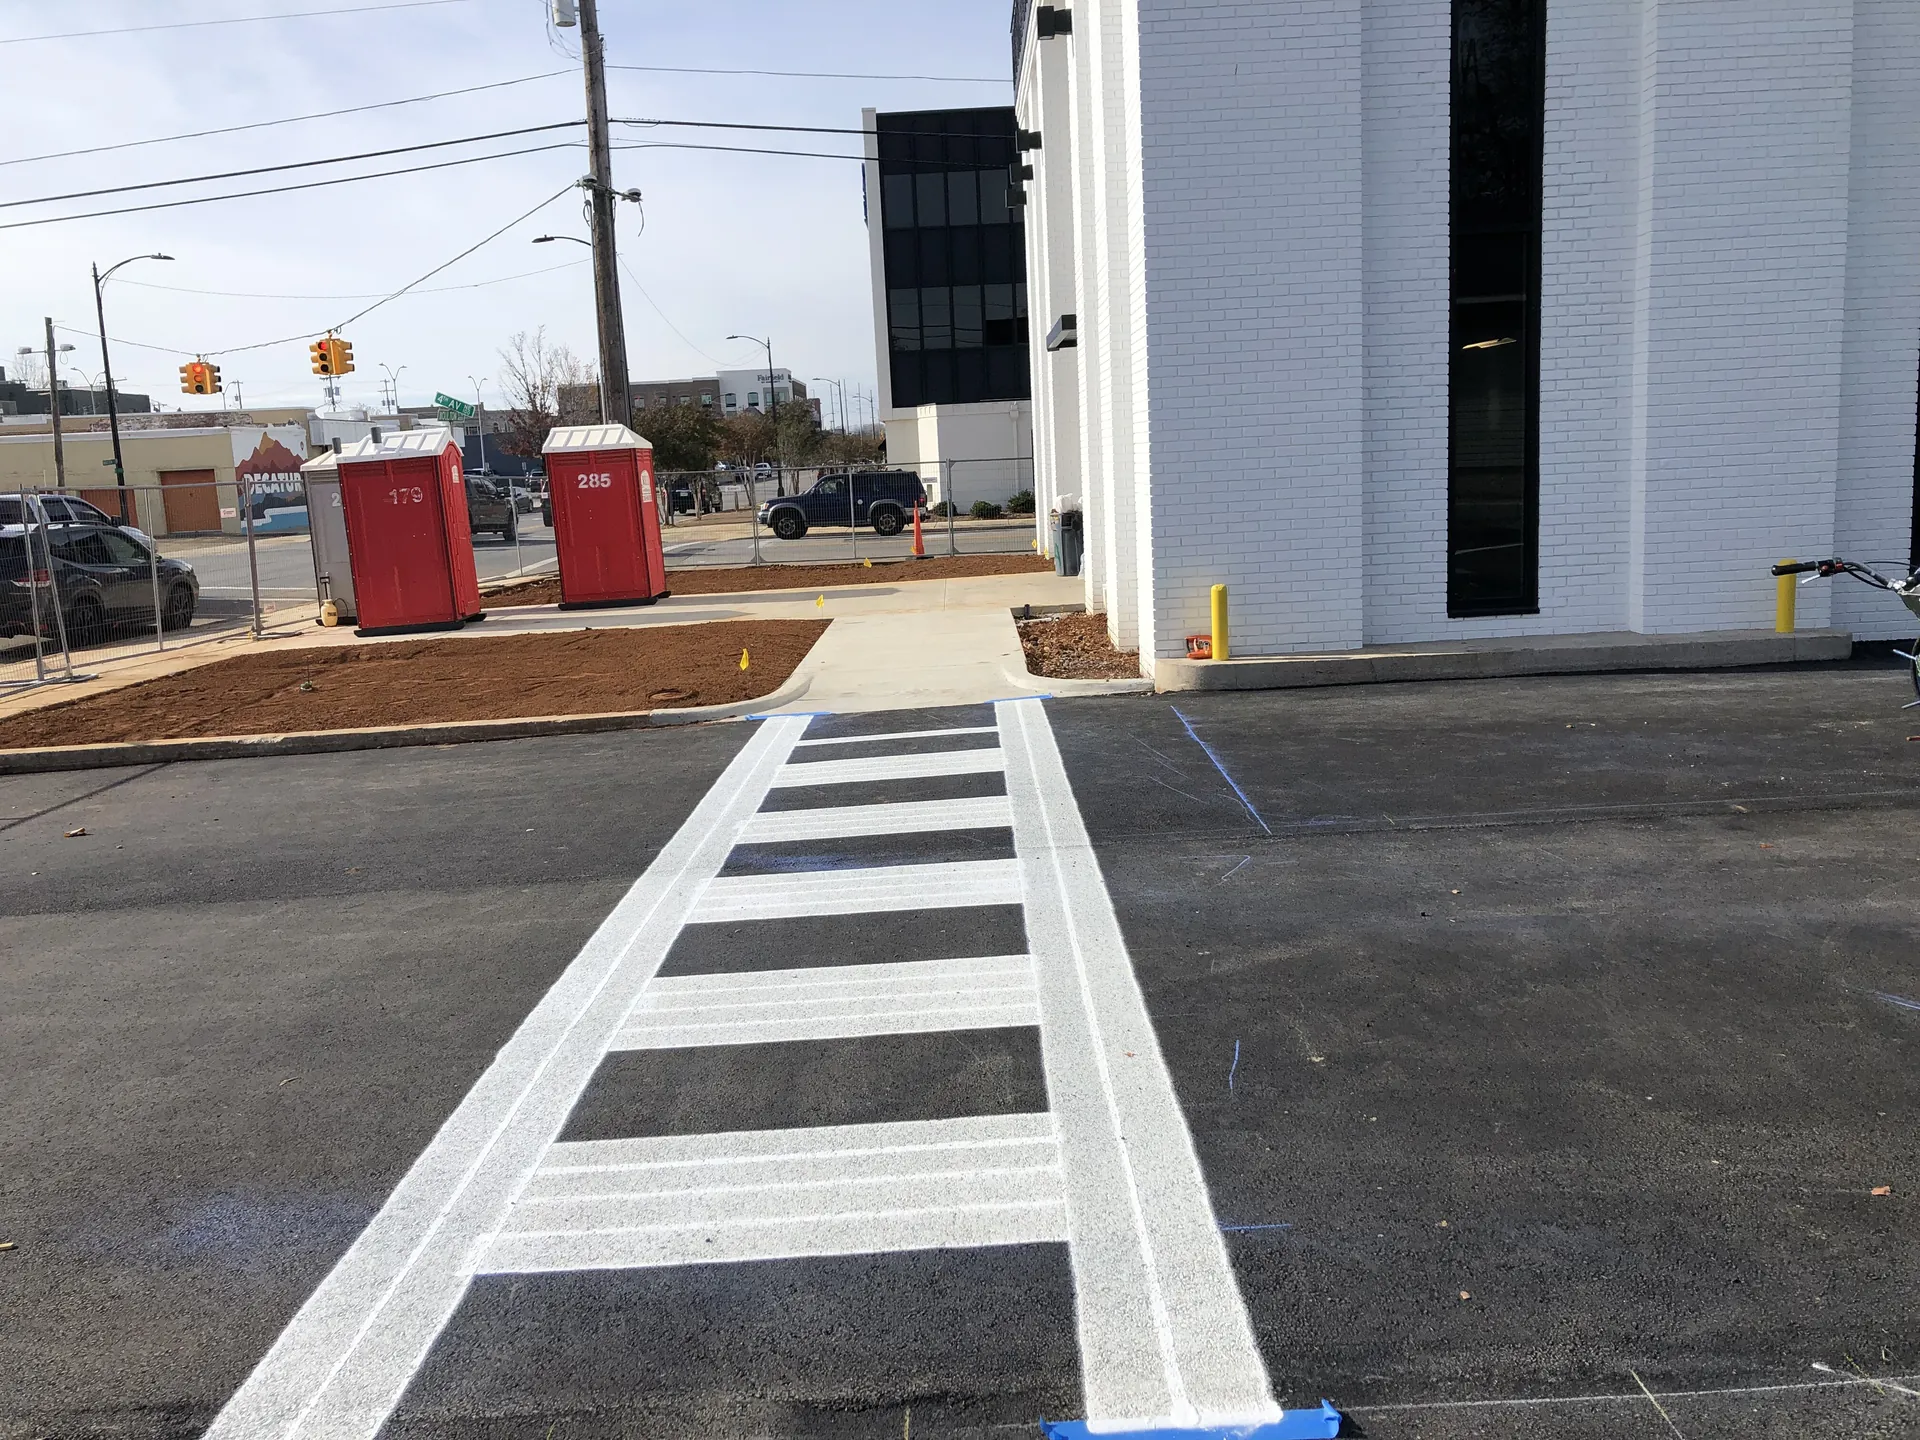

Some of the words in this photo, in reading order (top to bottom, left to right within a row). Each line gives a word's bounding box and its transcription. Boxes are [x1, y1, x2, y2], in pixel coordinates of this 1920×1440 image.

[448, 400, 461, 410] AV
[243, 472, 304, 495] DECATUR
[577, 473, 612, 489] 285
